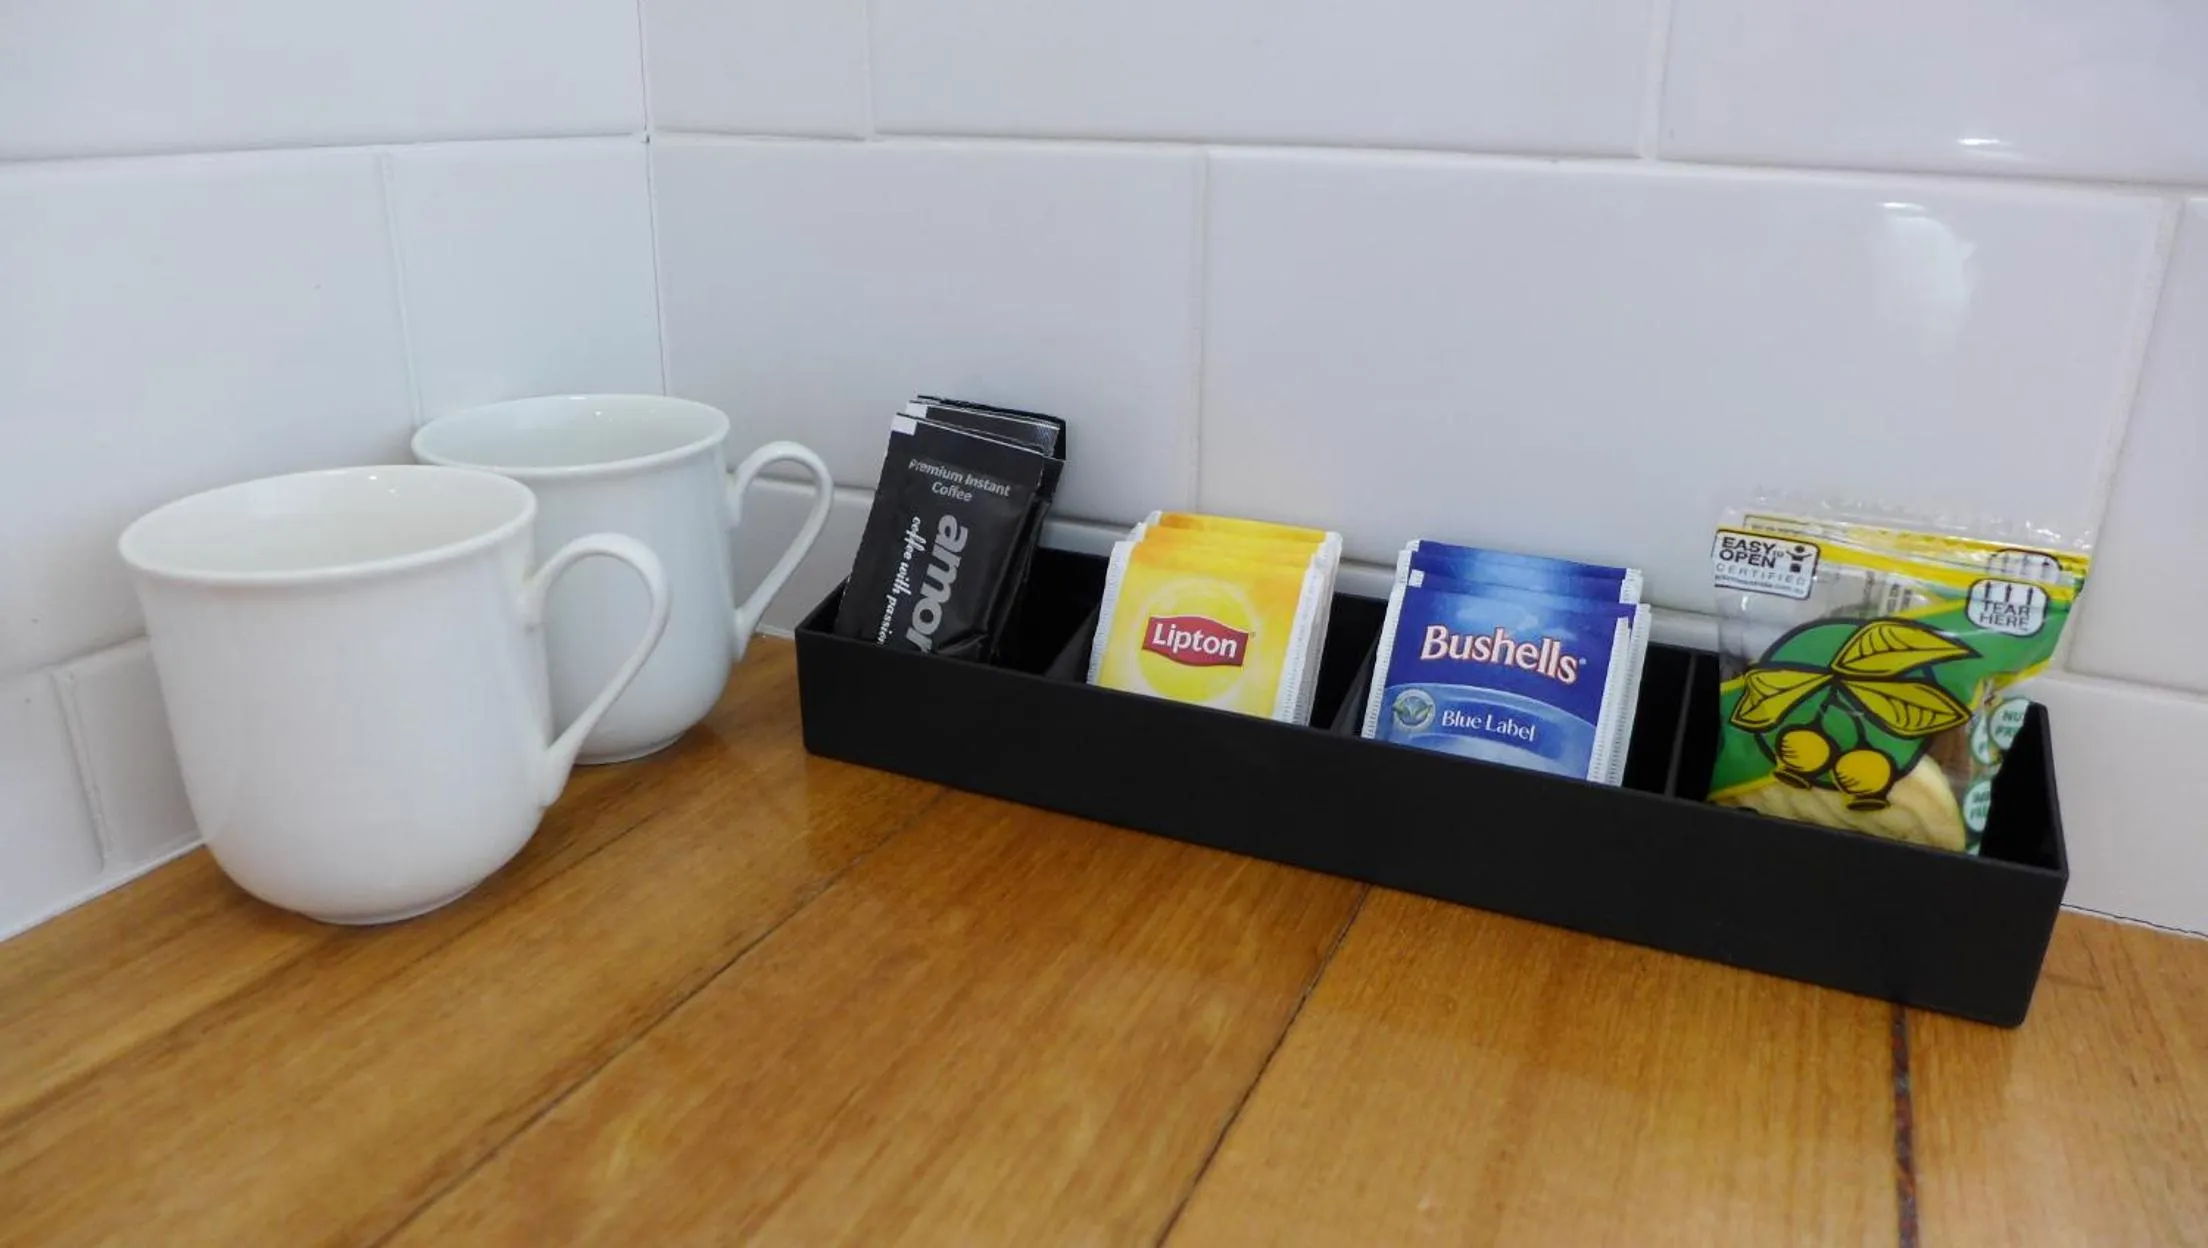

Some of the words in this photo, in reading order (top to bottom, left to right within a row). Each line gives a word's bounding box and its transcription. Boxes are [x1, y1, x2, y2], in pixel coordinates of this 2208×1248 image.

[908, 459, 963, 485] Premium
[965, 473, 1012, 497] Instant
[932, 481, 973, 502] Coffee
[903, 516, 927, 560] coffee
[1722, 536, 1776, 554] EASY
[1716, 563, 1806, 586] CERTIFIED
[1719, 548, 1776, 569] OPEN
[892, 561, 912, 595] with
[876, 594, 897, 645] passio
[1980, 613, 2029, 631] HERE
[1981, 600, 2030, 617] TEAR
[1152, 623, 1238, 658] Lipton
[1420, 624, 1580, 685] Bushells
[1441, 710, 1482, 729] Blue
[1485, 714, 1536, 742] Label
